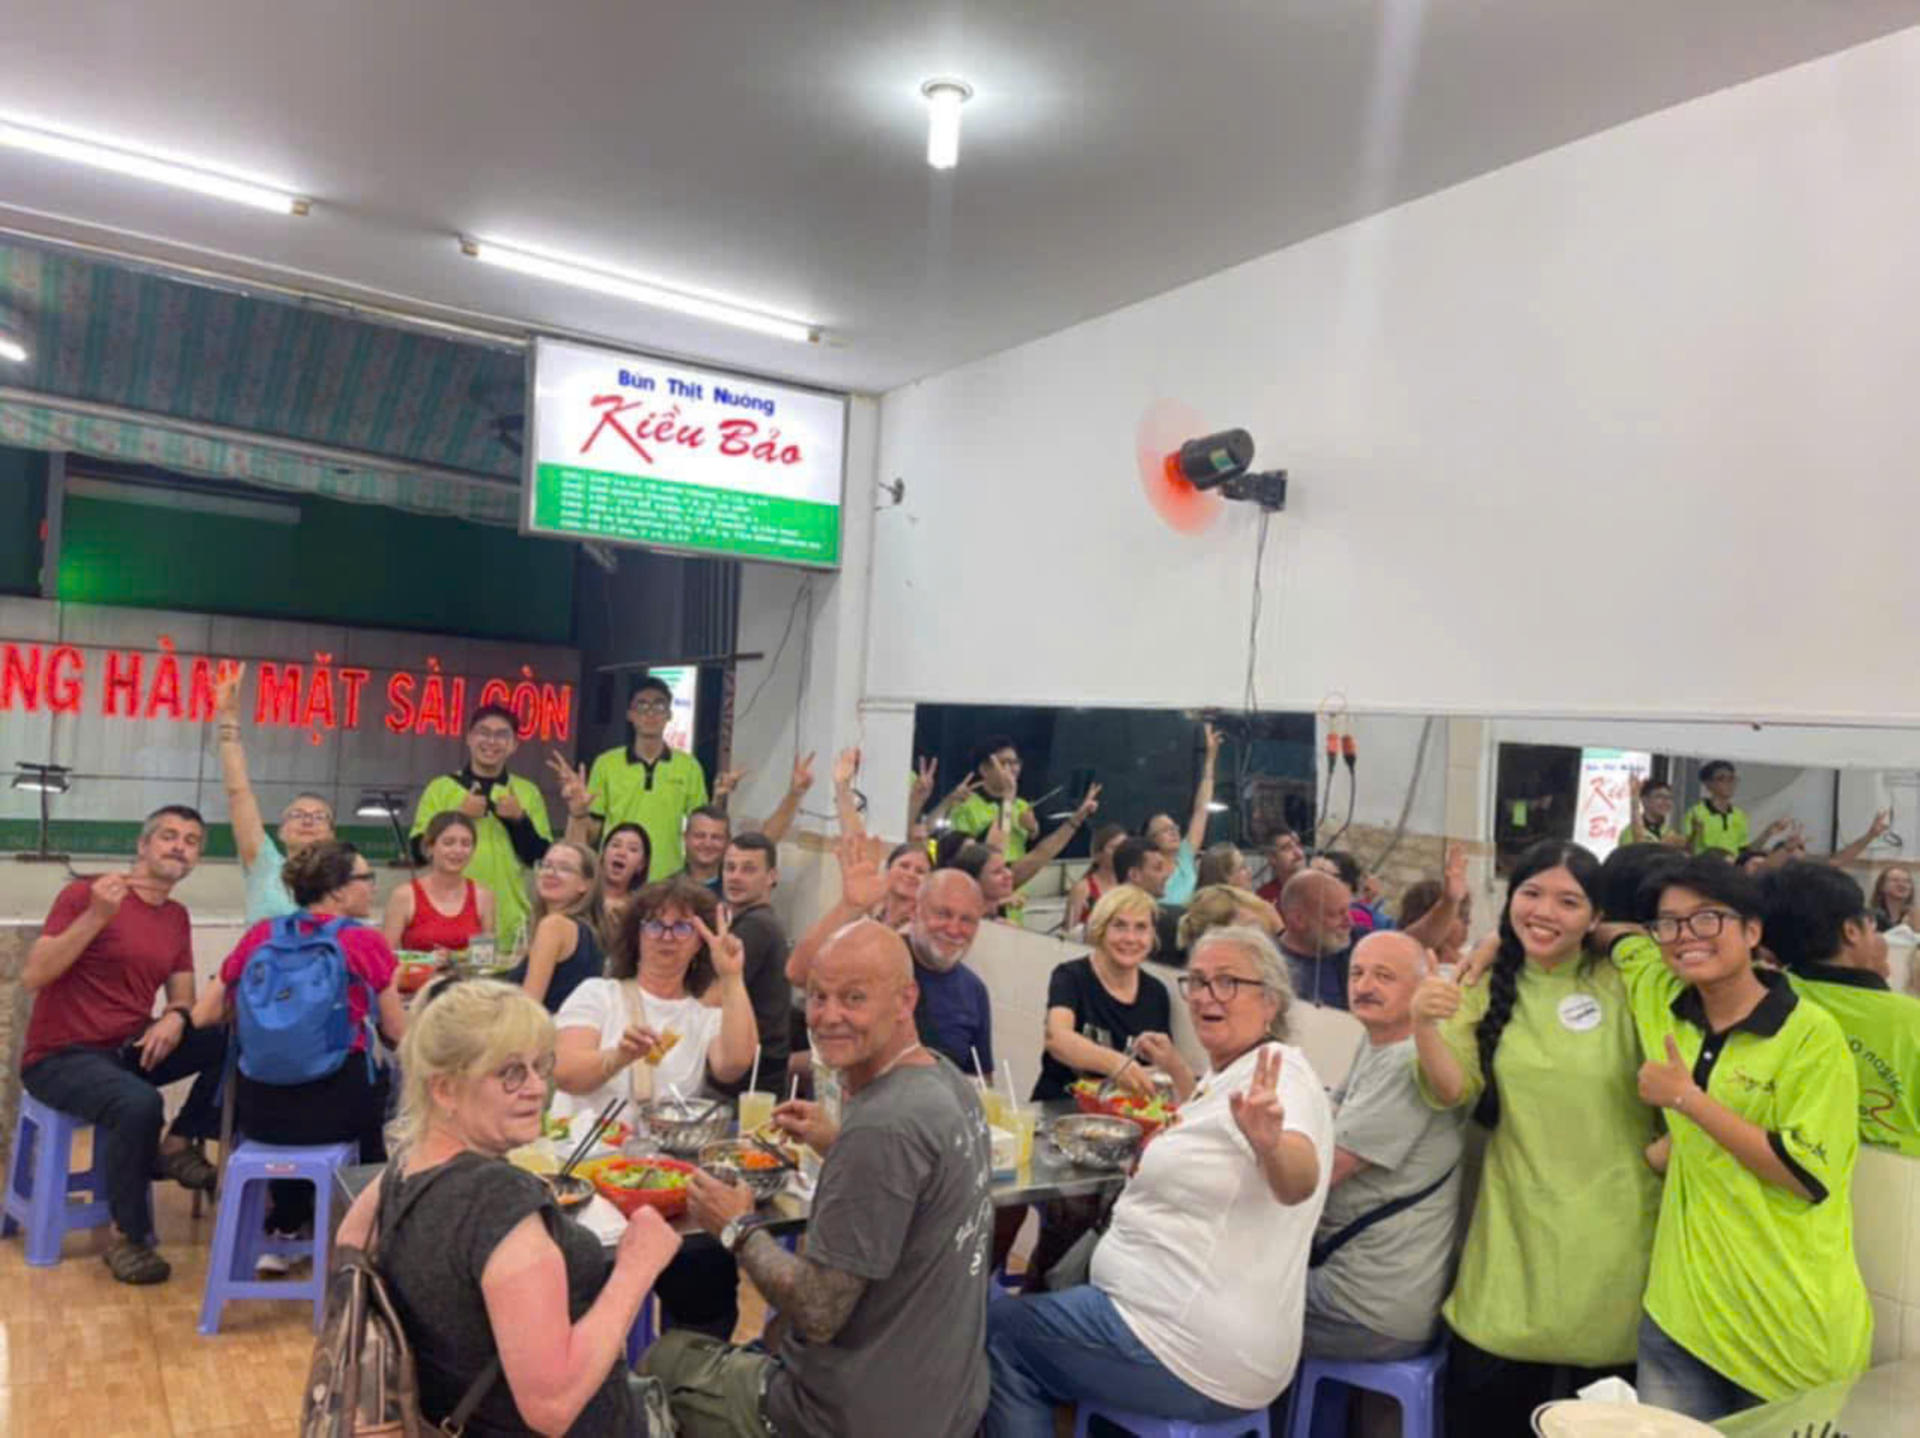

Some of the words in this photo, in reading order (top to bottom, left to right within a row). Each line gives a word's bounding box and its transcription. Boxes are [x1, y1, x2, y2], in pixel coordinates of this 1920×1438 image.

[579, 394, 706, 465] Kiều
[718, 418, 804, 465] Bảo
[254, 651, 372, 746] MẶT
[385, 656, 466, 737] SÀI
